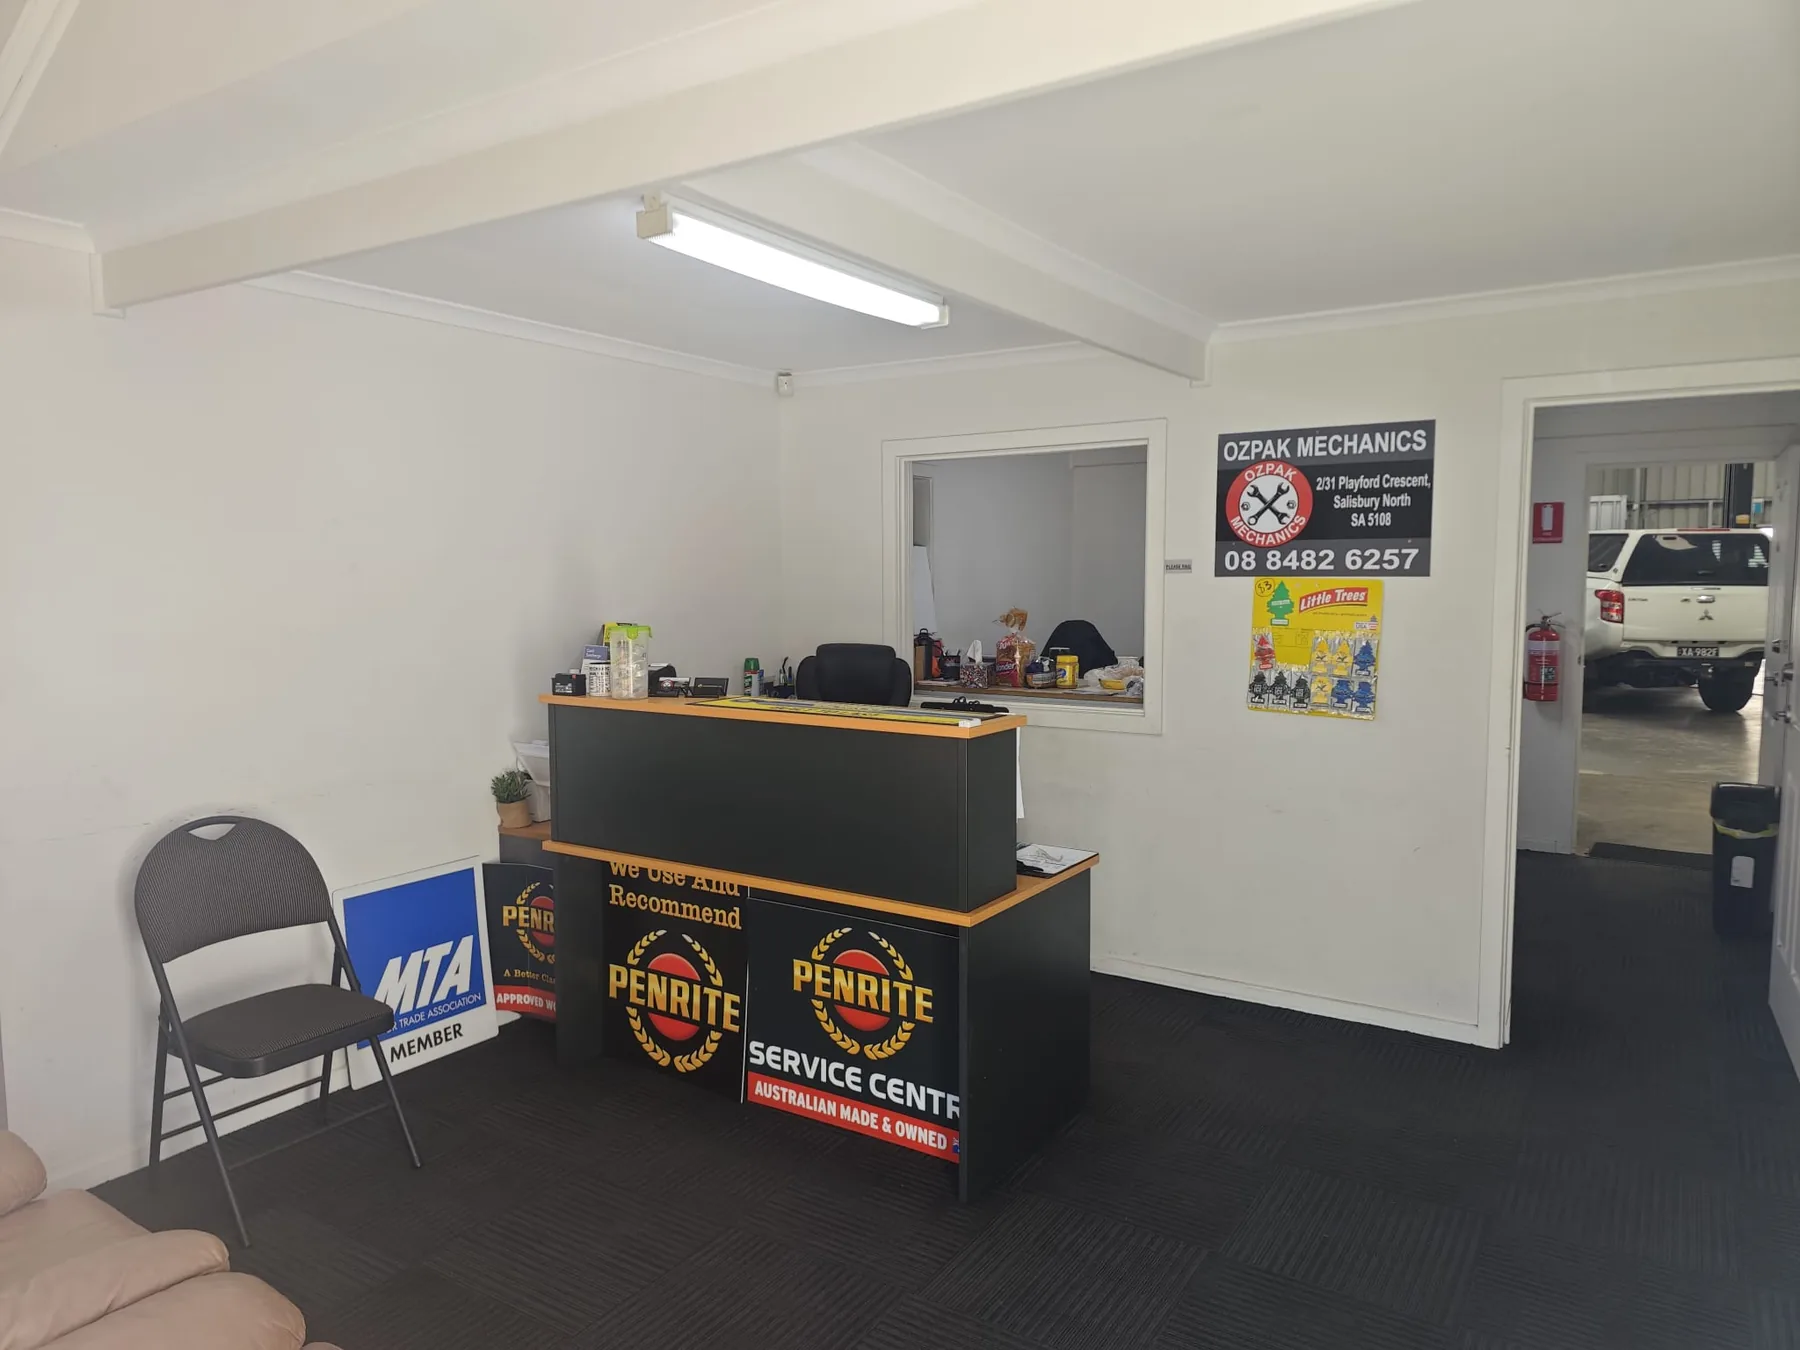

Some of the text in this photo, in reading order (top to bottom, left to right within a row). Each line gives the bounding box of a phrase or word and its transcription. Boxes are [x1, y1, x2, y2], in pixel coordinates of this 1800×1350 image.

[1223, 430, 1427, 461] OZPAK MECHANICS
[1244, 463, 1297, 482] OZPAK
[1316, 473, 1431, 493] 2/31 Playford Crescent,
[1333, 494, 1411, 511] Salisbury North
[1230, 515, 1307, 546] MECHANICS
[1351, 512, 1392, 527] SA 5108
[1224, 548, 1419, 571] 08 8482 6257
[1300, 589, 1365, 611] Little Trees
[609, 861, 741, 896] We Use And
[502, 905, 555, 933] PENR
[608, 884, 742, 929] Recommend
[374, 935, 474, 1016] MTA
[504, 969, 511, 977] A
[514, 970, 539, 981] Better
[496, 993, 544, 1009] APPROVED
[609, 963, 741, 1034] PENRITE
[792, 958, 935, 1025] PENRITE
[399, 1010, 426, 1030] TRADE
[427, 992, 482, 1019] ASSOCIATION
[391, 1022, 463, 1063] MEMBER
[749, 1040, 960, 1120] SERVICE CENTR
[754, 1080, 948, 1151] AUSTRALIAN MADE & OWNED
